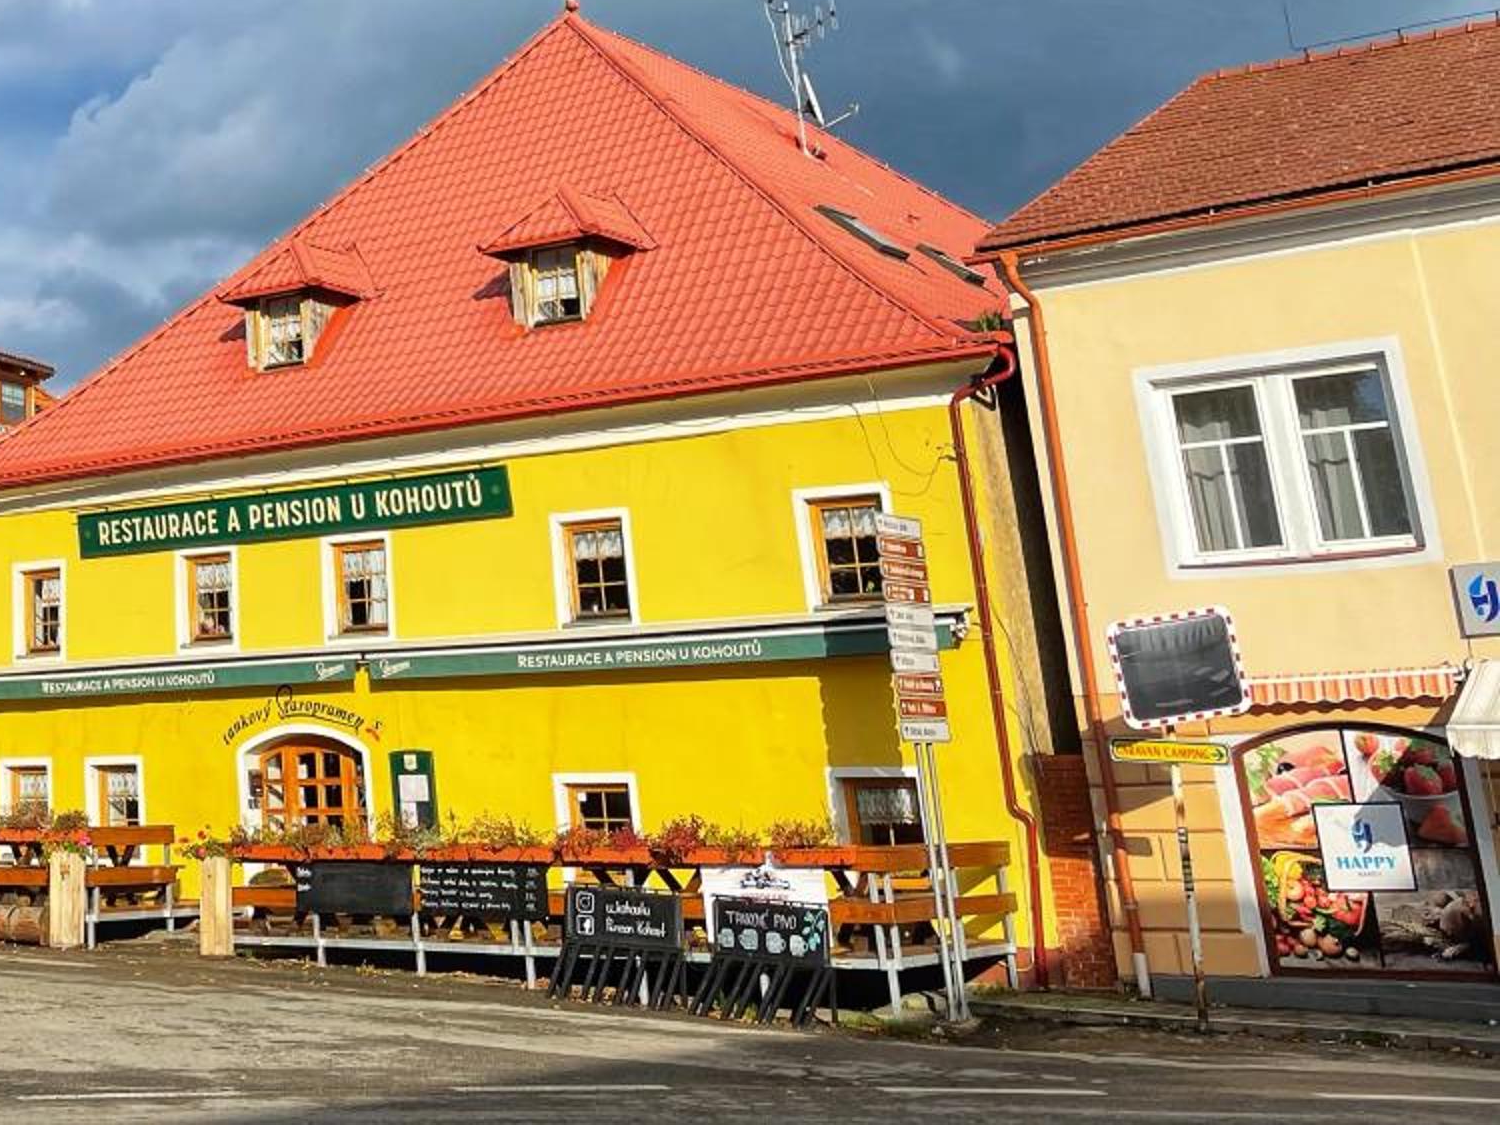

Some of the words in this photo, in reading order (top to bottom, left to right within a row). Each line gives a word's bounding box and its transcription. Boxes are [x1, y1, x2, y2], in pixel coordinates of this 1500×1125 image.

[98, 509, 219, 546] RESTAURACE
[227, 506, 241, 532] A
[248, 496, 341, 530] PENSION
[351, 492, 365, 520] U
[375, 473, 483, 518] KOHOUTŮ
[517, 652, 602, 668] RESTAURACE
[604, 653, 614, 664] A
[616, 647, 677, 663] PENSION
[679, 646, 689, 659] U
[692, 639, 762, 659] KOHOUTŮ
[276, 684, 365, 734] Staropramen
[1336, 856, 1396, 870] HAPPY
